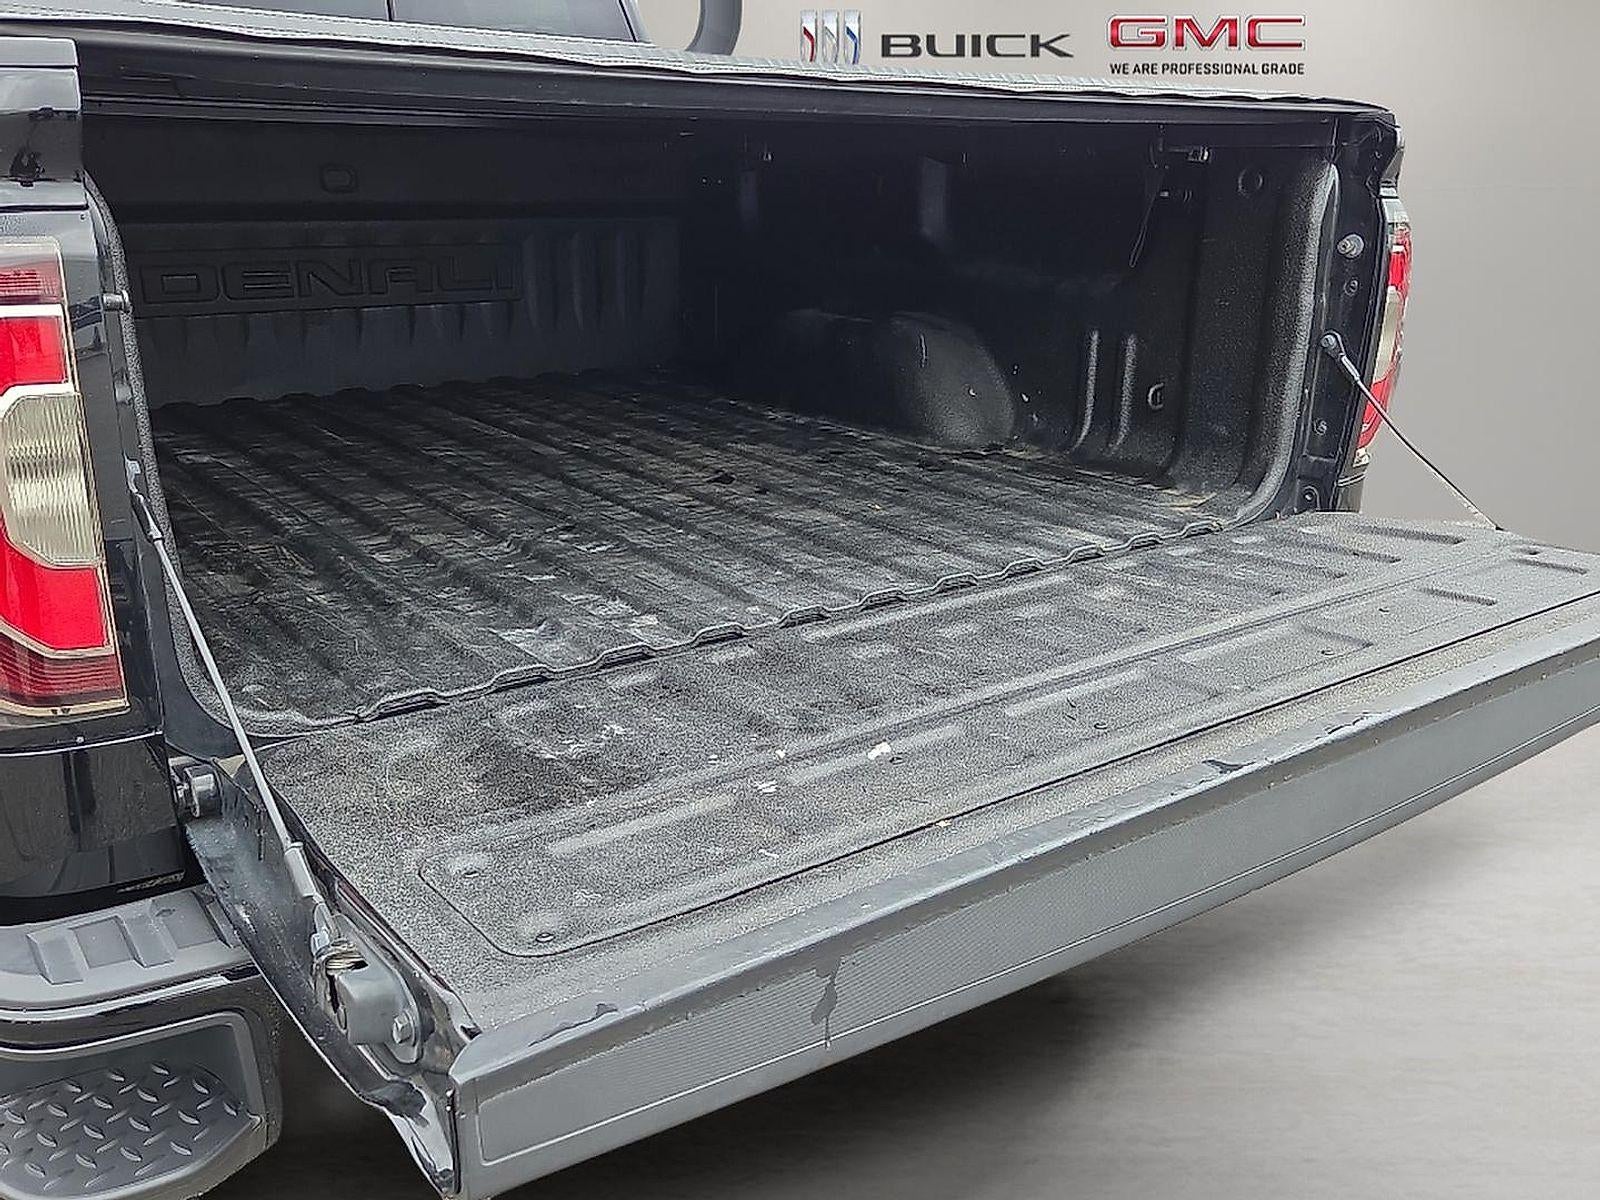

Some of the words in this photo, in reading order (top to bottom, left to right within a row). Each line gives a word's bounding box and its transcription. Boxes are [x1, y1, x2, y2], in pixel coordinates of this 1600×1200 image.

[881, 33, 1074, 58] BUICK
[1108, 15, 1306, 50] GMC
[1109, 63, 1130, 75] WE
[1132, 63, 1158, 75] ARE
[1161, 63, 1259, 75] PROFESSIONAL
[1261, 63, 1305, 75] GRADE
[140, 255, 514, 304] DENALI
